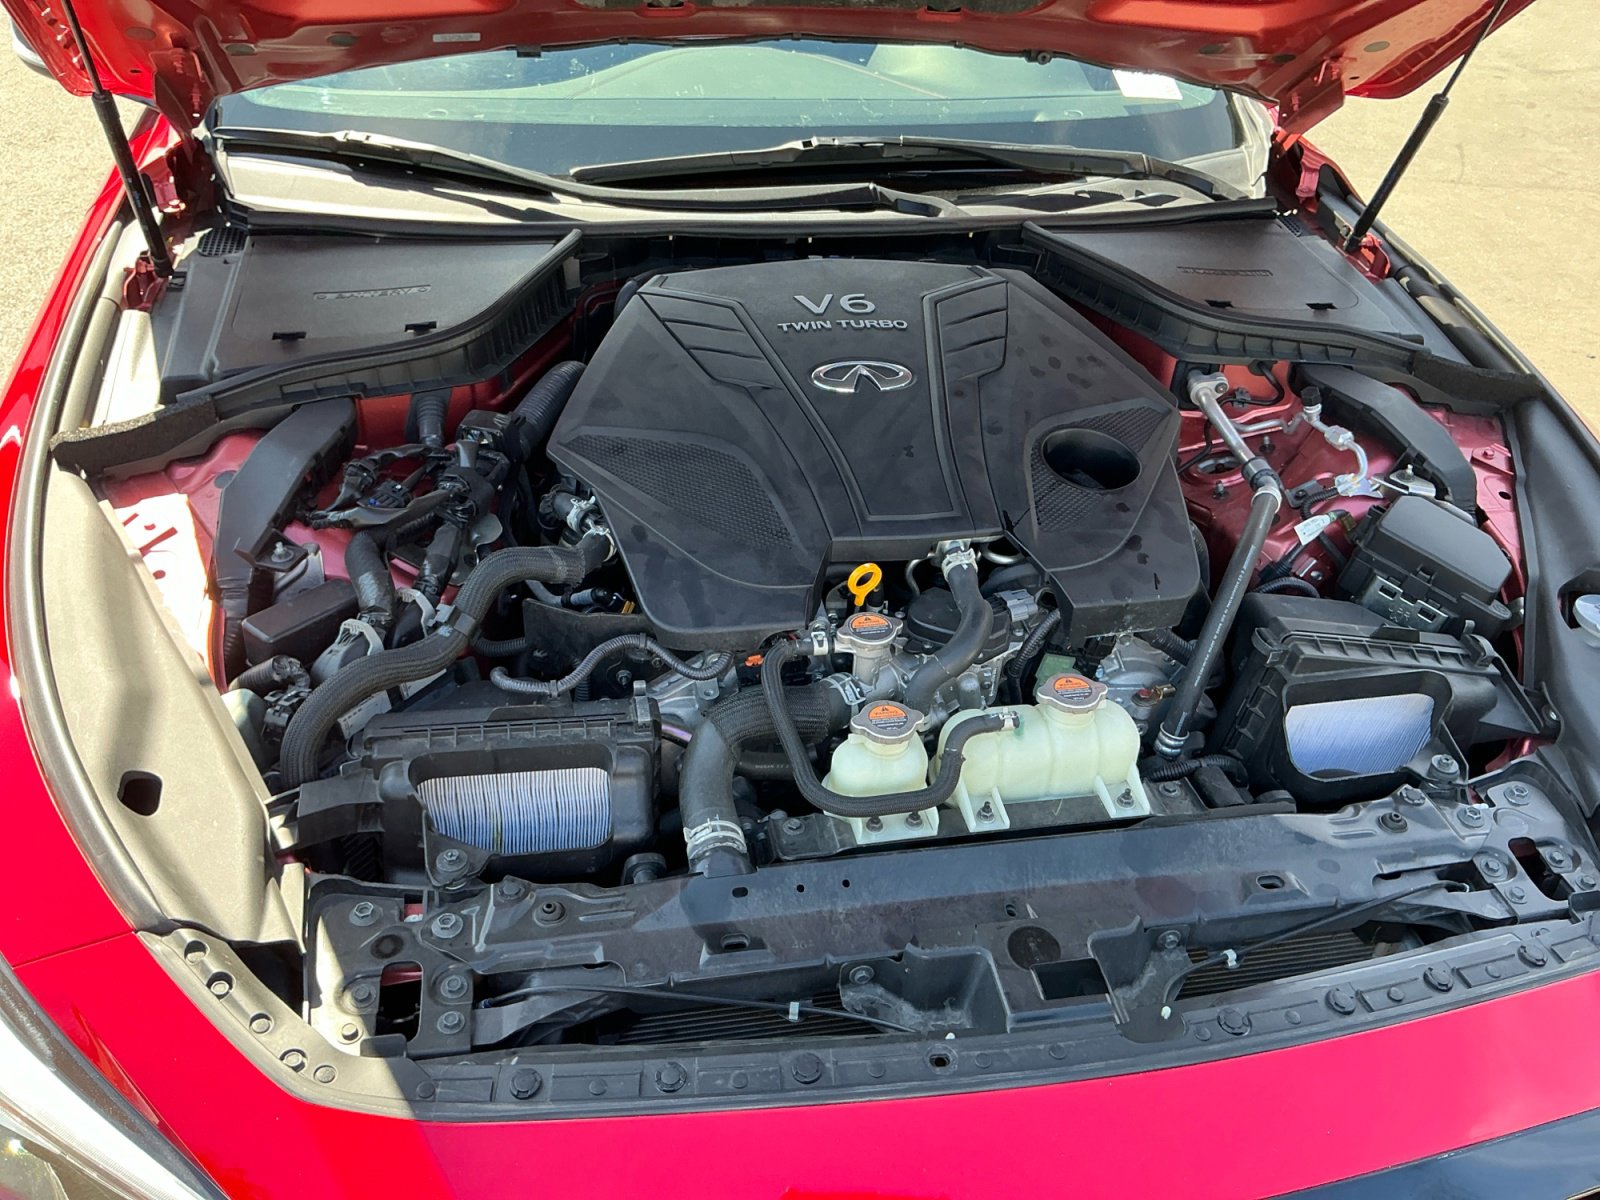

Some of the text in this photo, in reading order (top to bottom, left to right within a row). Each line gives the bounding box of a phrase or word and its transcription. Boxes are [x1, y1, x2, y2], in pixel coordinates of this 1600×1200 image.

[793, 293, 876, 315] V6
[777, 319, 908, 332] TWIN TURBO
